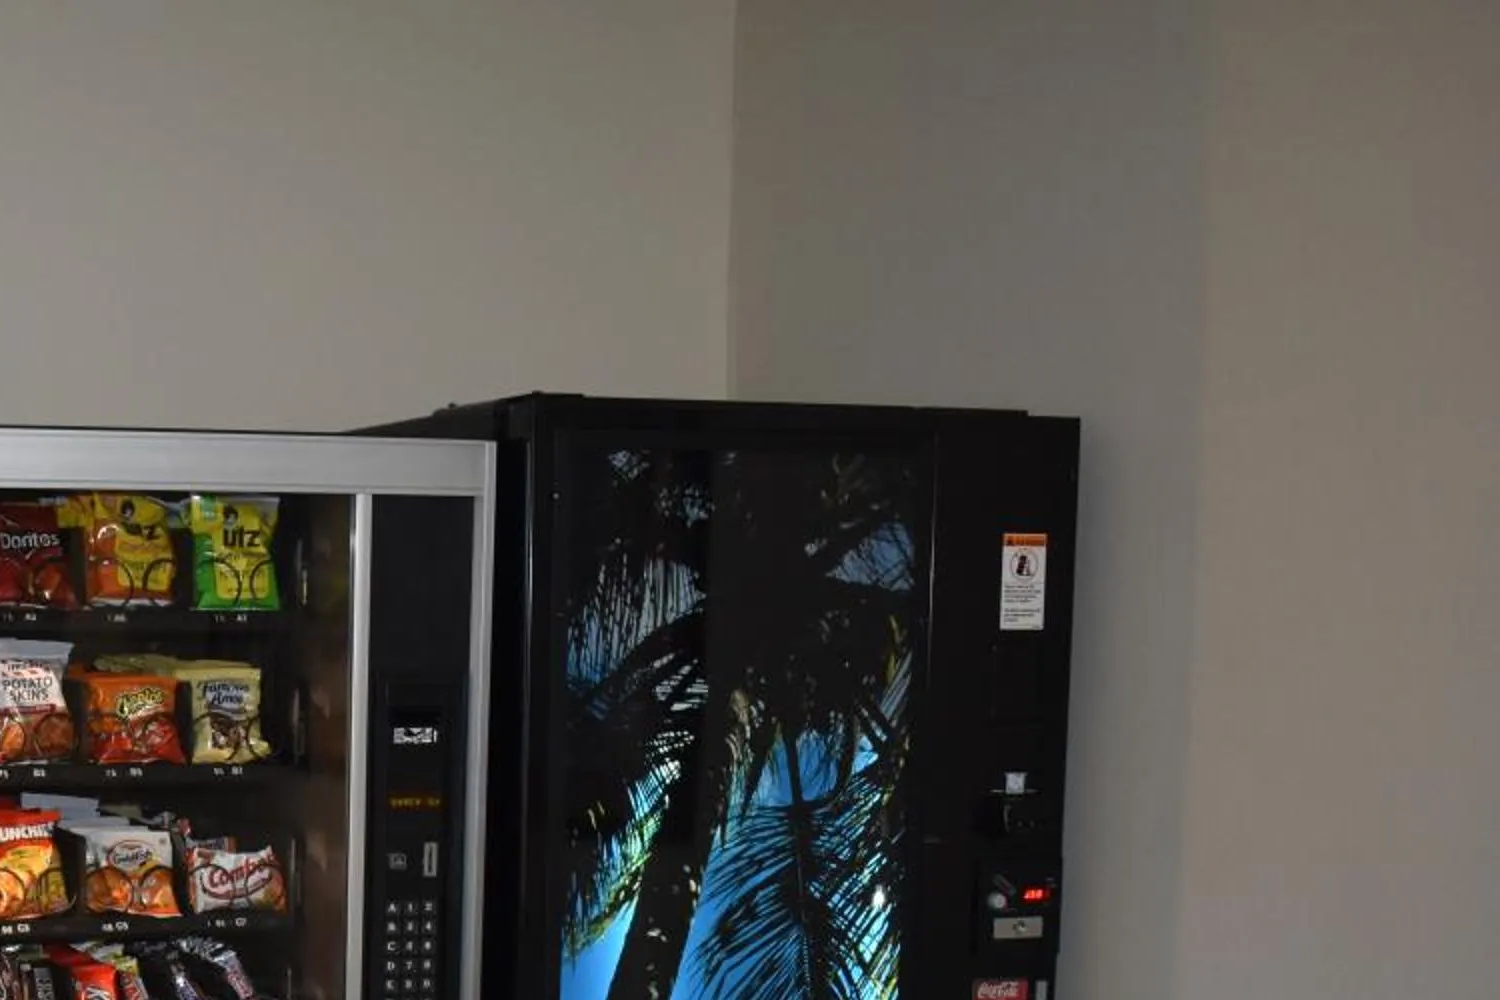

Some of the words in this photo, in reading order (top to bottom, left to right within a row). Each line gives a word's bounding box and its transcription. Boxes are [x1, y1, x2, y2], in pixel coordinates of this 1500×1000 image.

[0, 531, 61, 550] Doritos
[2, 676, 52, 691] POTATO
[9, 688, 49, 705] SKINS
[388, 903, 397, 912] A
[387, 941, 397, 951] C
[387, 961, 396, 971] D
